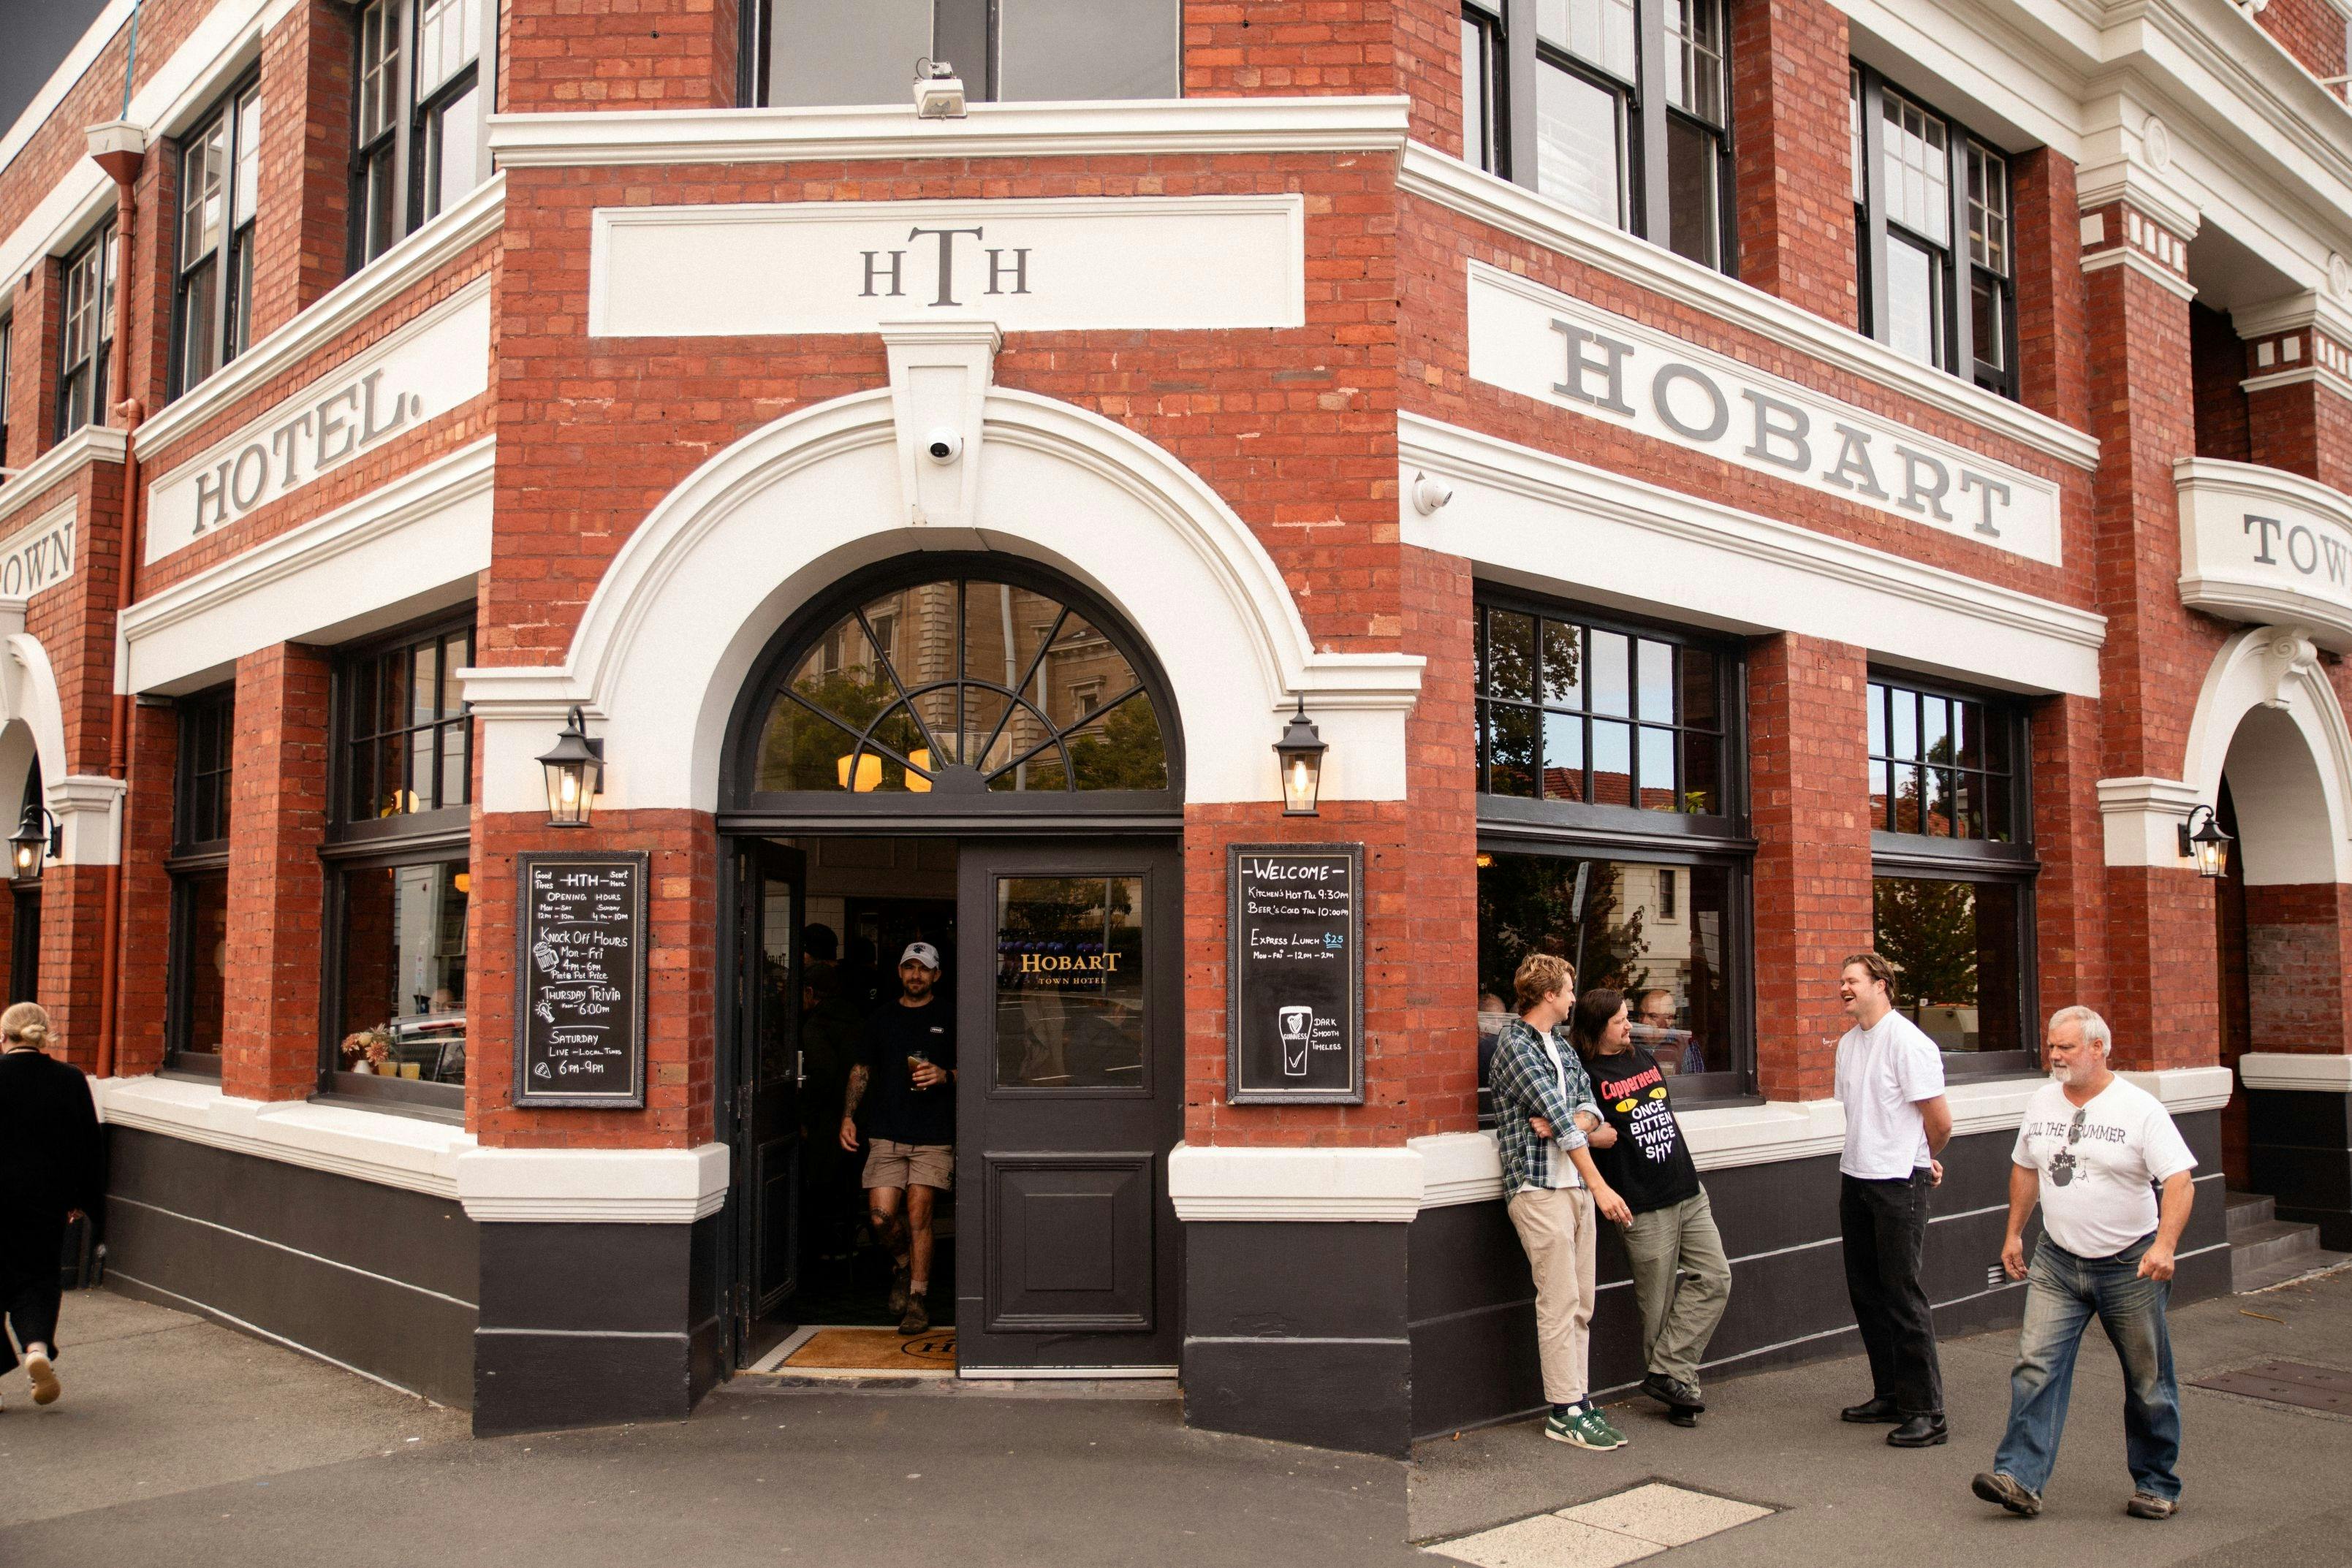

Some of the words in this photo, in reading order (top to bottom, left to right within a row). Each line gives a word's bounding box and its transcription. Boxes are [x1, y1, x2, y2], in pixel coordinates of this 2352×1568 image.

[858, 227, 1033, 307] HTH
[1550, 318, 2011, 538] HOBART
[0, 522, 73, 595] OWN
[2244, 514, 2352, 587] TOW
[547, 892, 587, 902] OPENING
[1285, 890, 1302, 899] HOT
[541, 926, 571, 943] KNOCK
[594, 931, 629, 947] HOURS
[1251, 929, 1288, 946] EXPRESS
[1291, 933, 1319, 945] LUNCH
[1323, 932, 1343, 945] $25
[1021, 952, 1121, 973] HOBART
[589, 971, 609, 979] Price
[541, 986, 585, 1003] THURSDAY
[1314, 1018, 1337, 1026] DARK
[549, 1031, 599, 1046] SATURDAY
[1312, 1029, 1339, 1038] SMOOTH
[549, 1047, 569, 1057] LIVE
[1310, 1040, 1341, 1051] TIMELESS
[1631, 1099, 1666, 1119] ONCE
[1629, 1111, 1673, 1135] BITTEN
[2046, 1122, 2066, 1138] THE
[1635, 1125, 1675, 1147] TWICE
[1646, 1141, 1672, 1163] SHY
